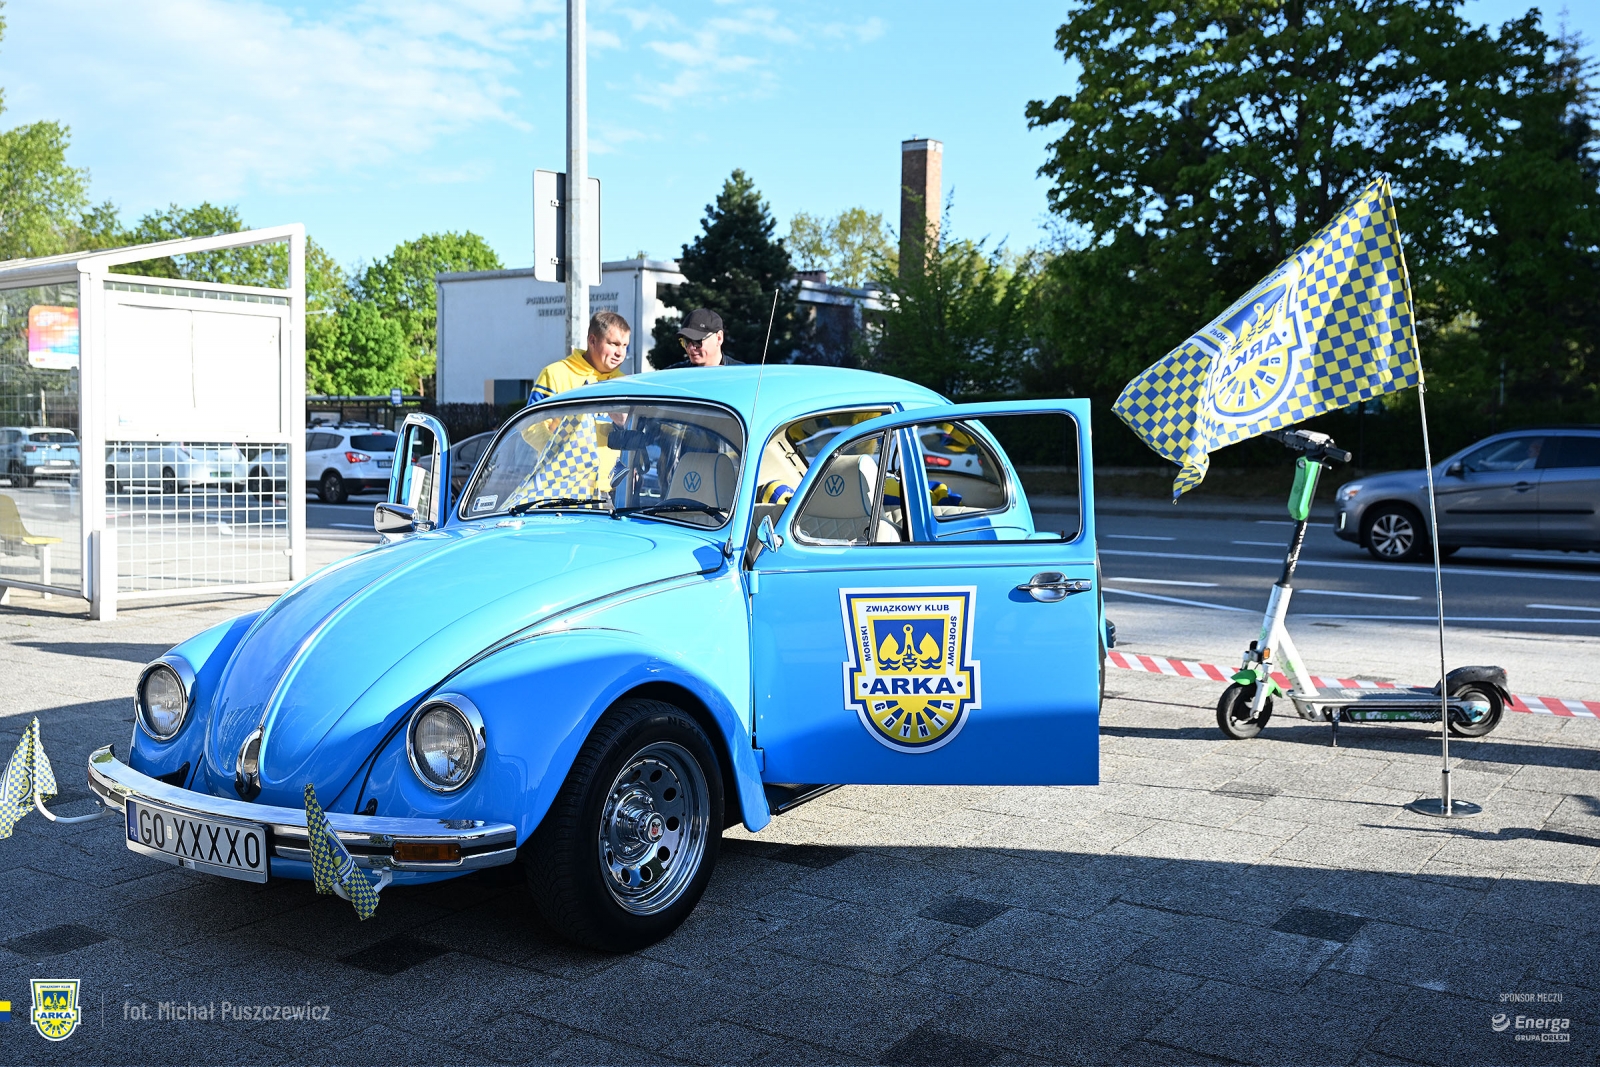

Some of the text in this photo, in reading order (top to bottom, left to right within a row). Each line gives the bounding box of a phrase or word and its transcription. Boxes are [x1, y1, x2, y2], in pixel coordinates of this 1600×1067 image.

[865, 605, 922, 613] ZWIĄZKOWY
[860, 625, 872, 662] MORSKI
[947, 615, 958, 667] SPORTOWY
[869, 677, 956, 695] ARKA
[874, 702, 954, 737] GDYNIA
[130, 826, 137, 837] PL
